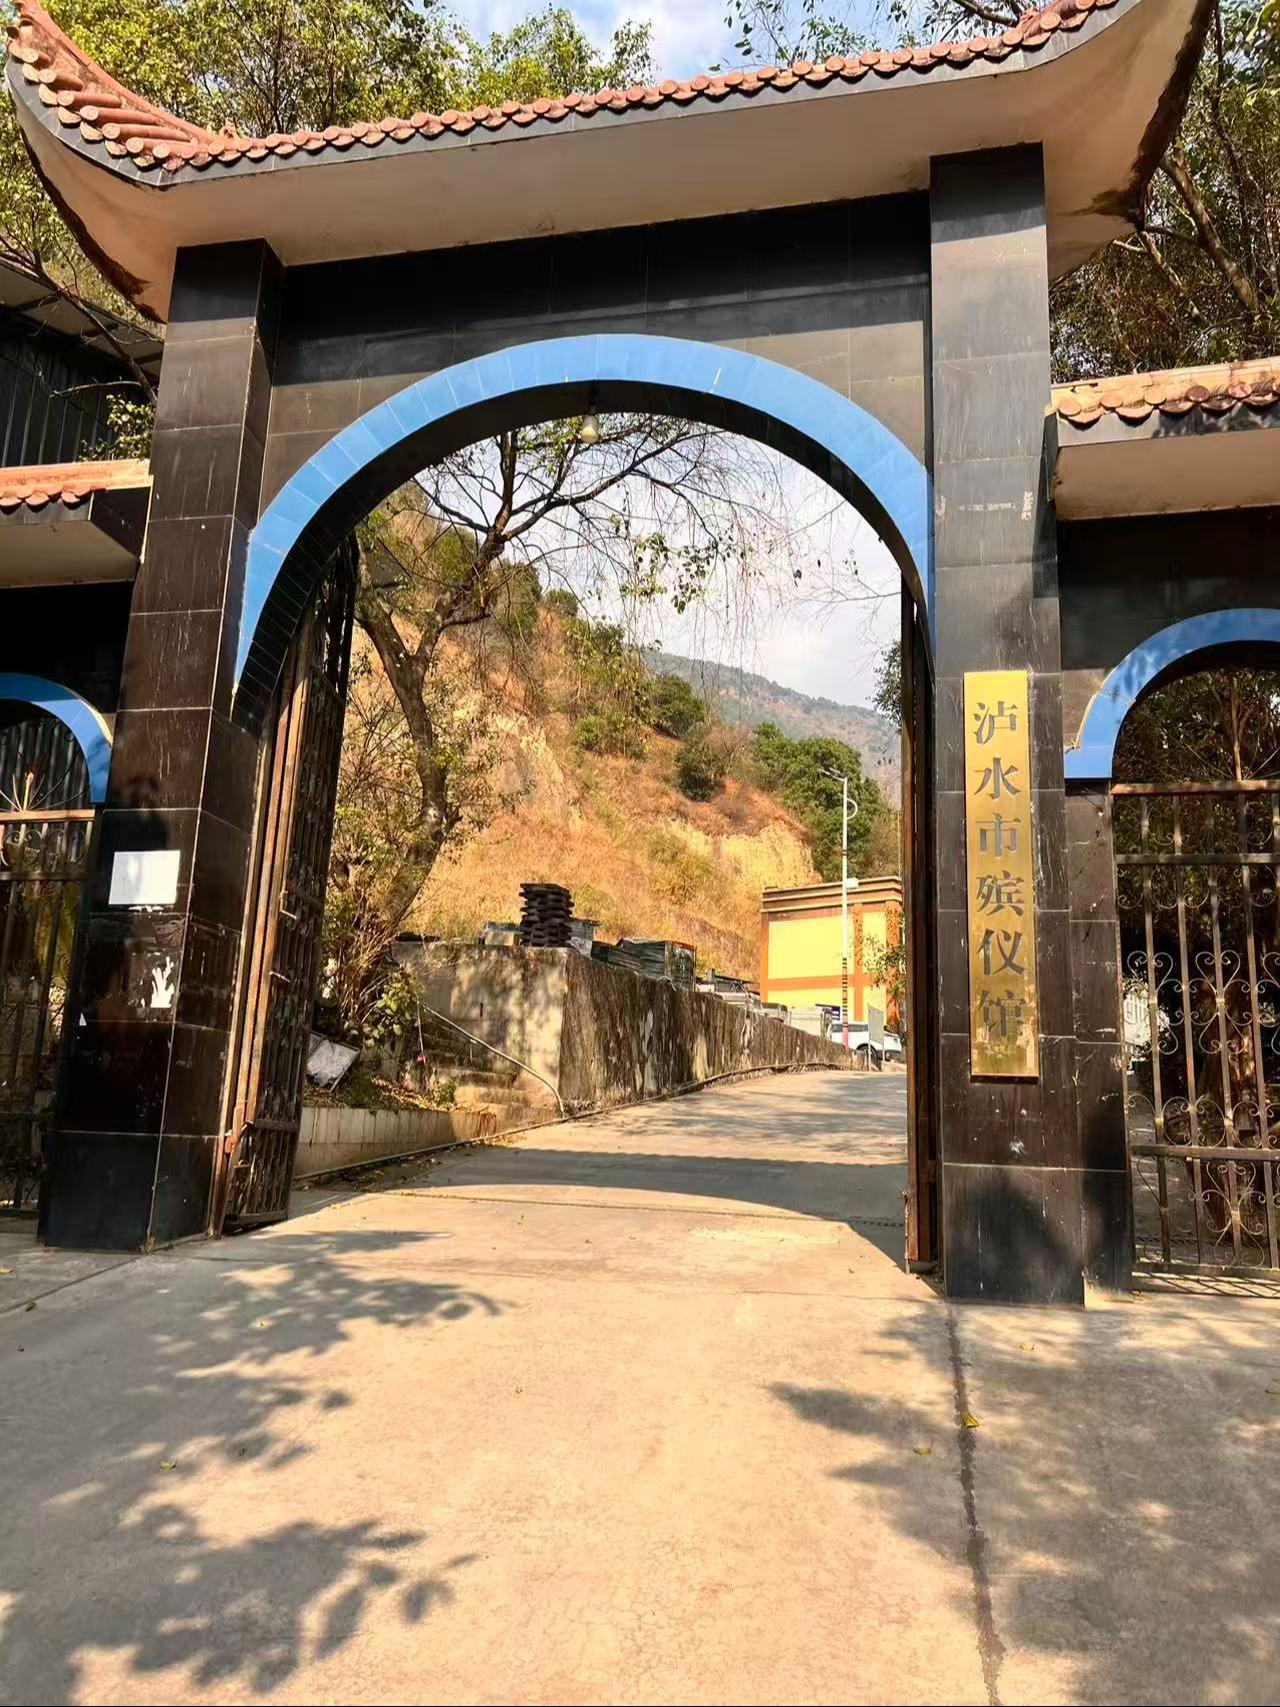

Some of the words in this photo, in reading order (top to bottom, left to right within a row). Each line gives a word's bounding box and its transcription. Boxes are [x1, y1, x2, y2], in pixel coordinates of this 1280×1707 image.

[973, 701, 1025, 1039] 泸水市殡仪馆
